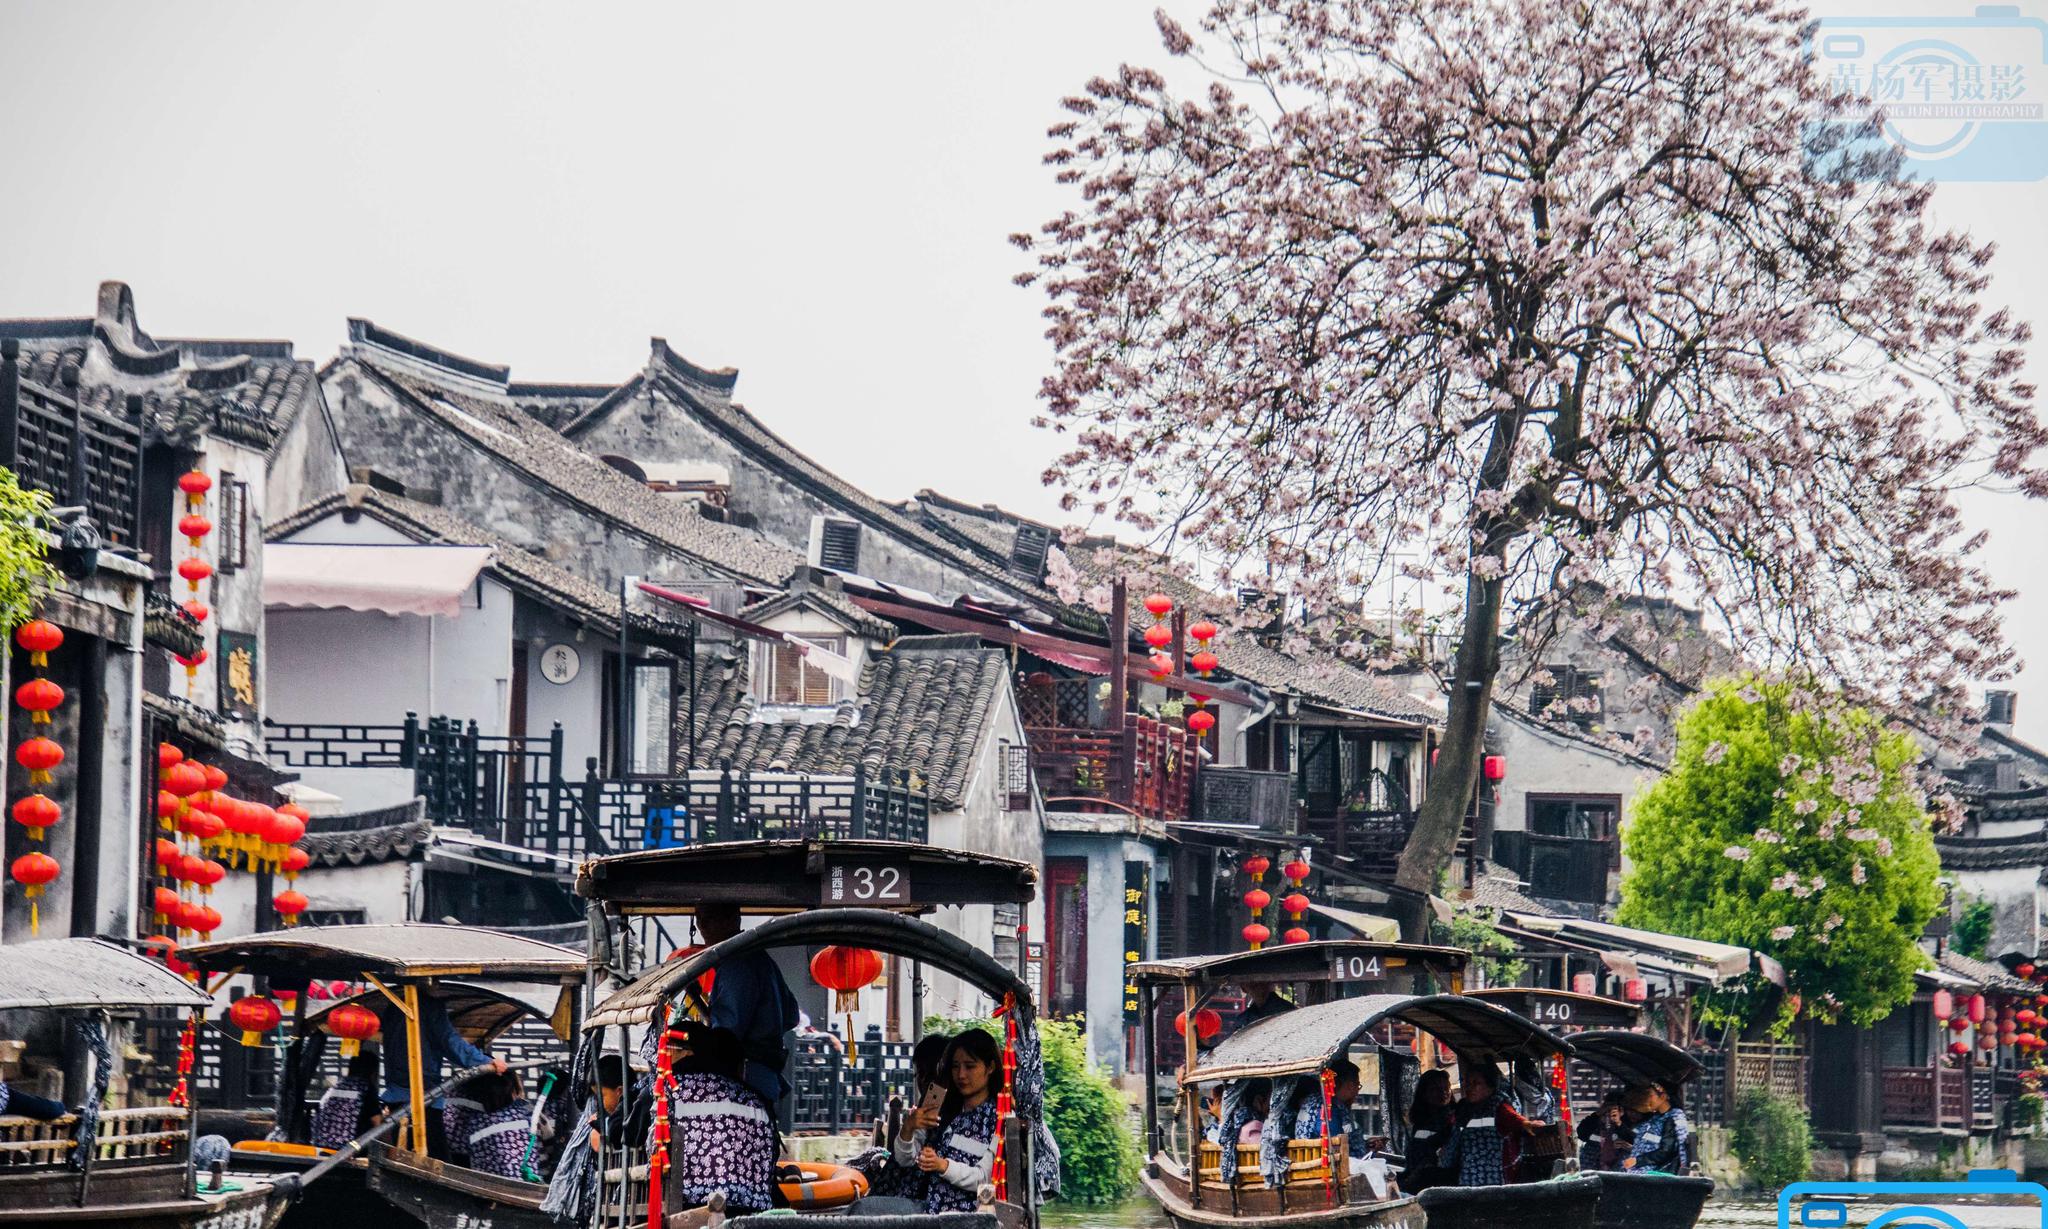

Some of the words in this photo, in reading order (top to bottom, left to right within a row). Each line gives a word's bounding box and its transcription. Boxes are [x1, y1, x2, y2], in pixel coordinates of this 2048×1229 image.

[832, 866, 844, 900] 浙西游
[854, 867, 900, 899] 32
[1350, 956, 1380, 977] 04
[1546, 1003, 1570, 1020] 40
